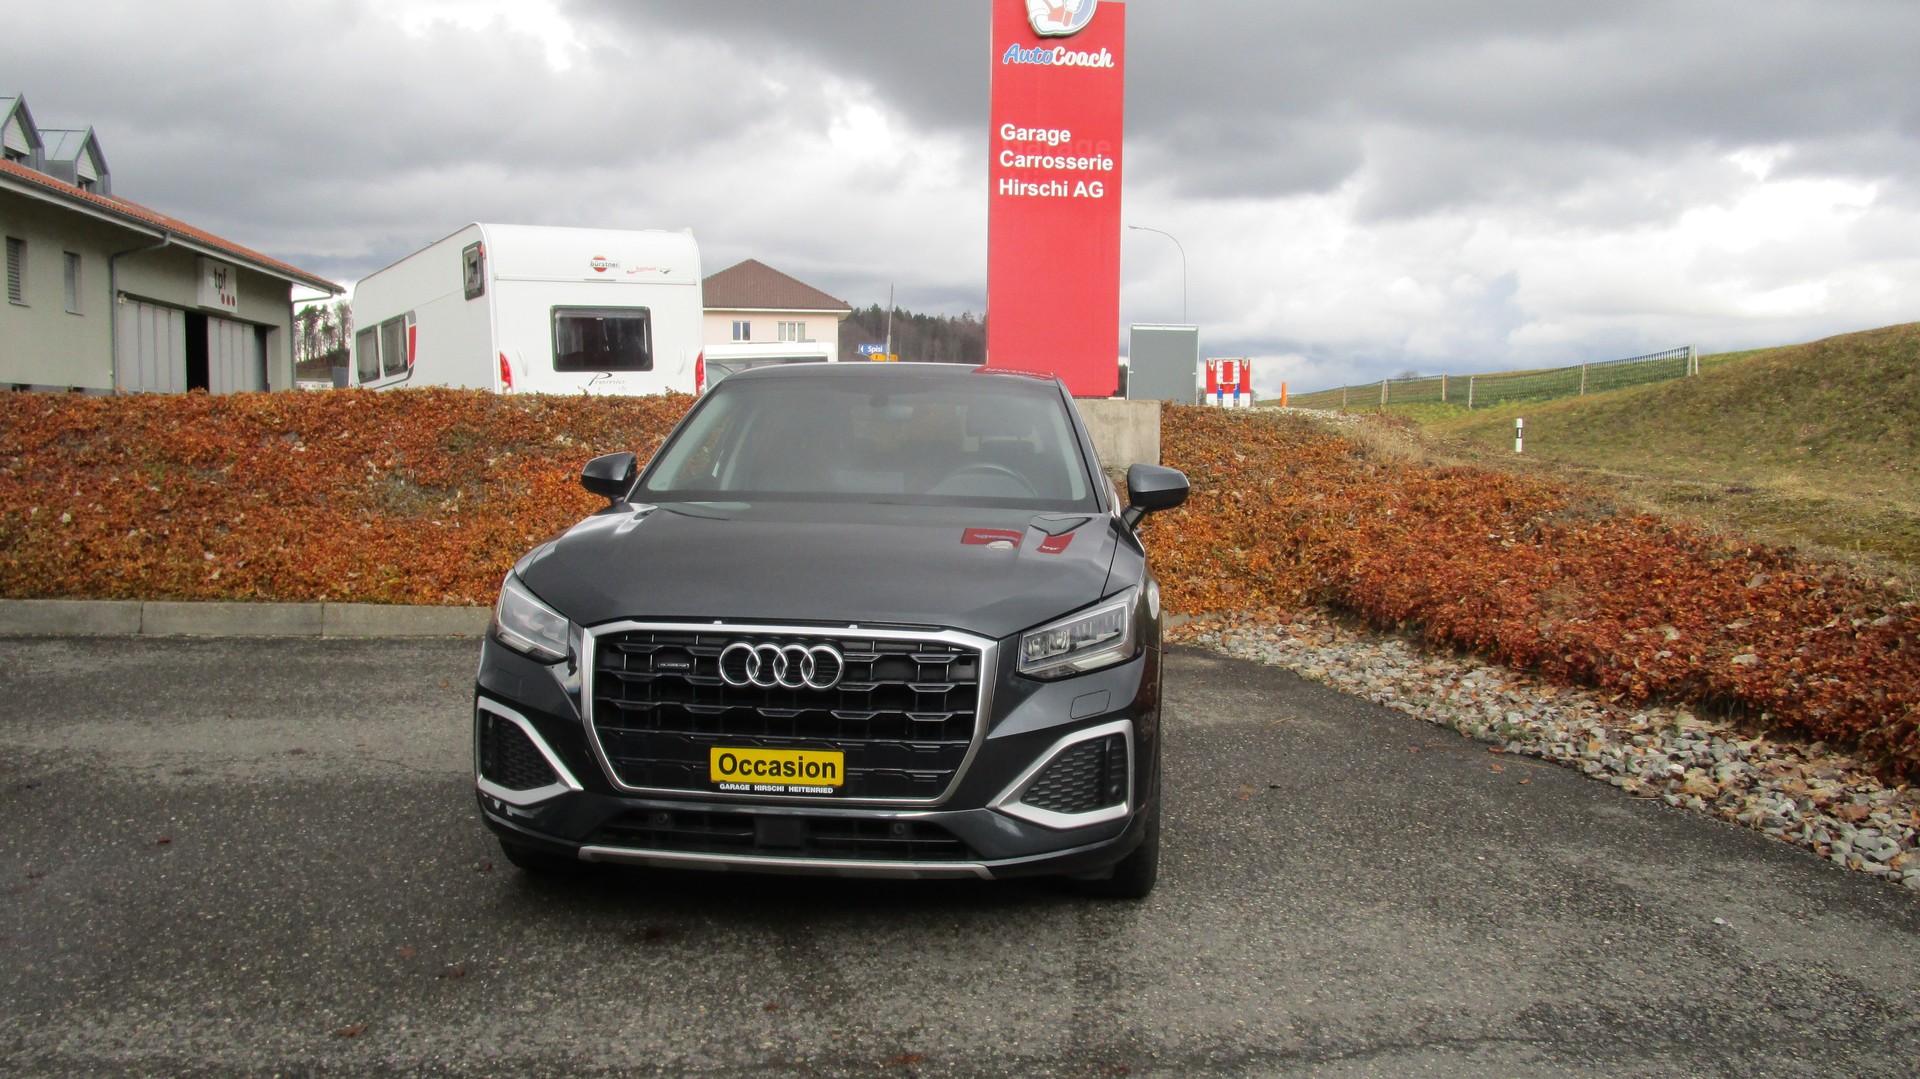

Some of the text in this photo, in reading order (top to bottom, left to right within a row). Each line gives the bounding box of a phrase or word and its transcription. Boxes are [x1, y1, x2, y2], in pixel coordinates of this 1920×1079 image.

[1003, 43, 1114, 68] AutoCoach
[1000, 123, 1071, 146] Garage
[1000, 150, 1113, 171] Carrosserie
[999, 178, 1104, 198] Hirschi AG
[214, 267, 226, 294] tpf
[718, 752, 836, 779] Occasion
[719, 783, 833, 794] GARAGE HIRSCHI HEITENRIED
